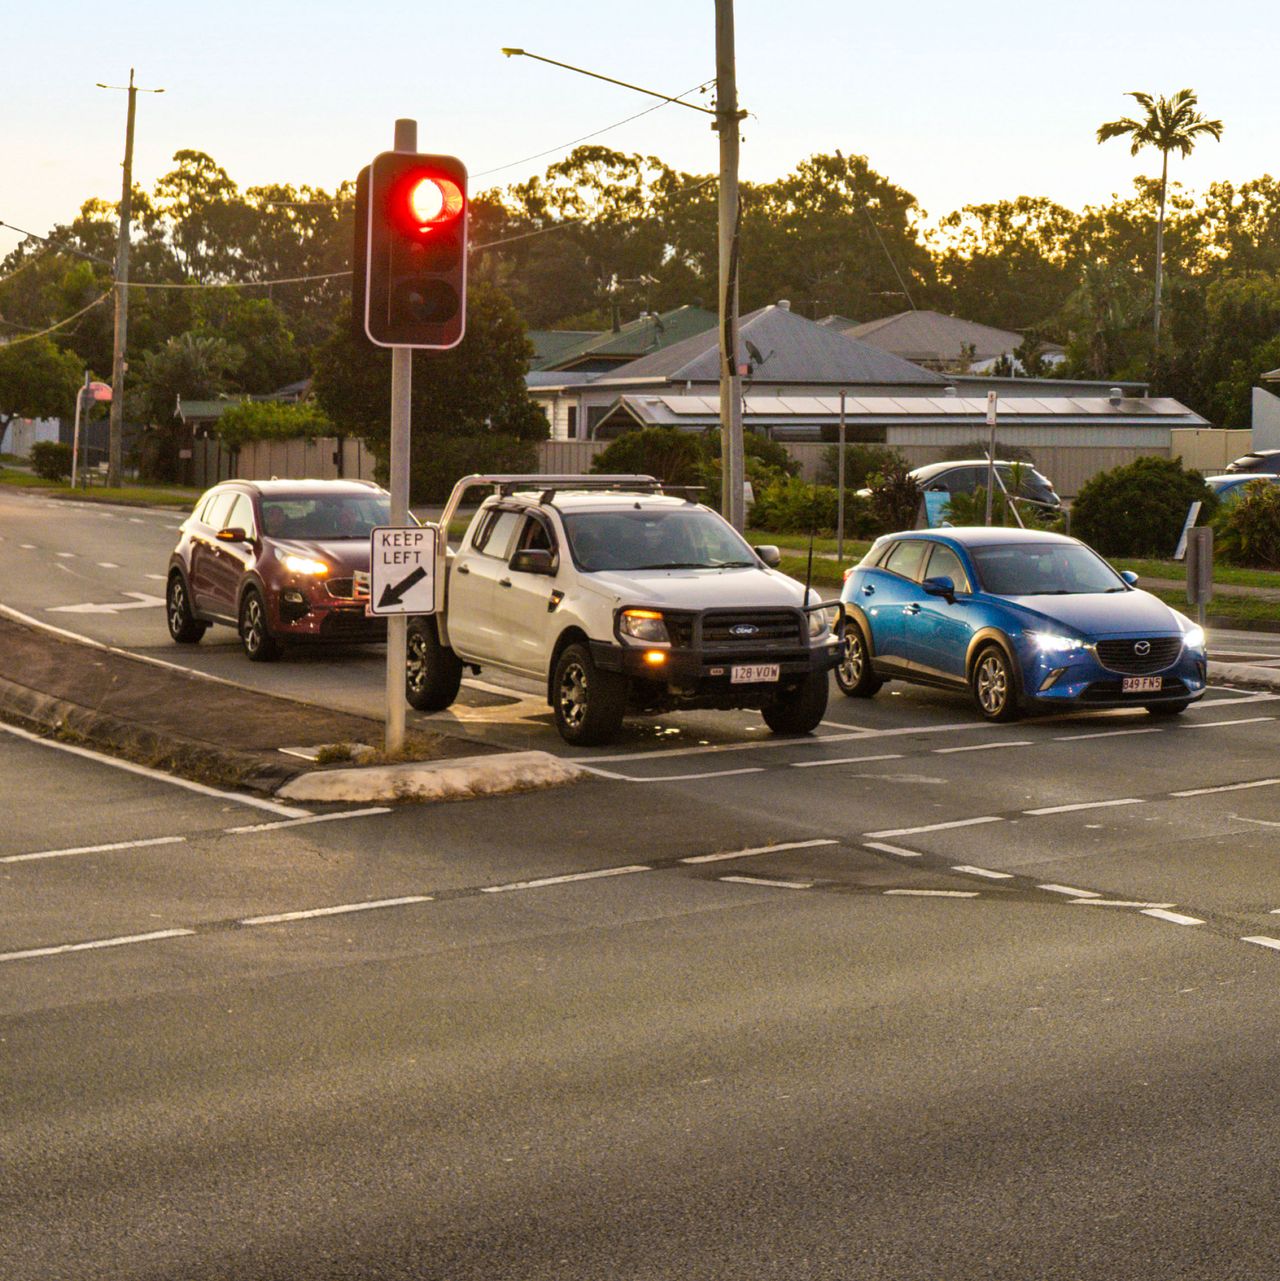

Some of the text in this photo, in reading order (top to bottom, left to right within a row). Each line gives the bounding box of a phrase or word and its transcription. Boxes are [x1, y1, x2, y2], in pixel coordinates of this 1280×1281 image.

[382, 533, 424, 547] KEEP
[383, 551, 421, 565] LEFT
[734, 667, 753, 679] 128
